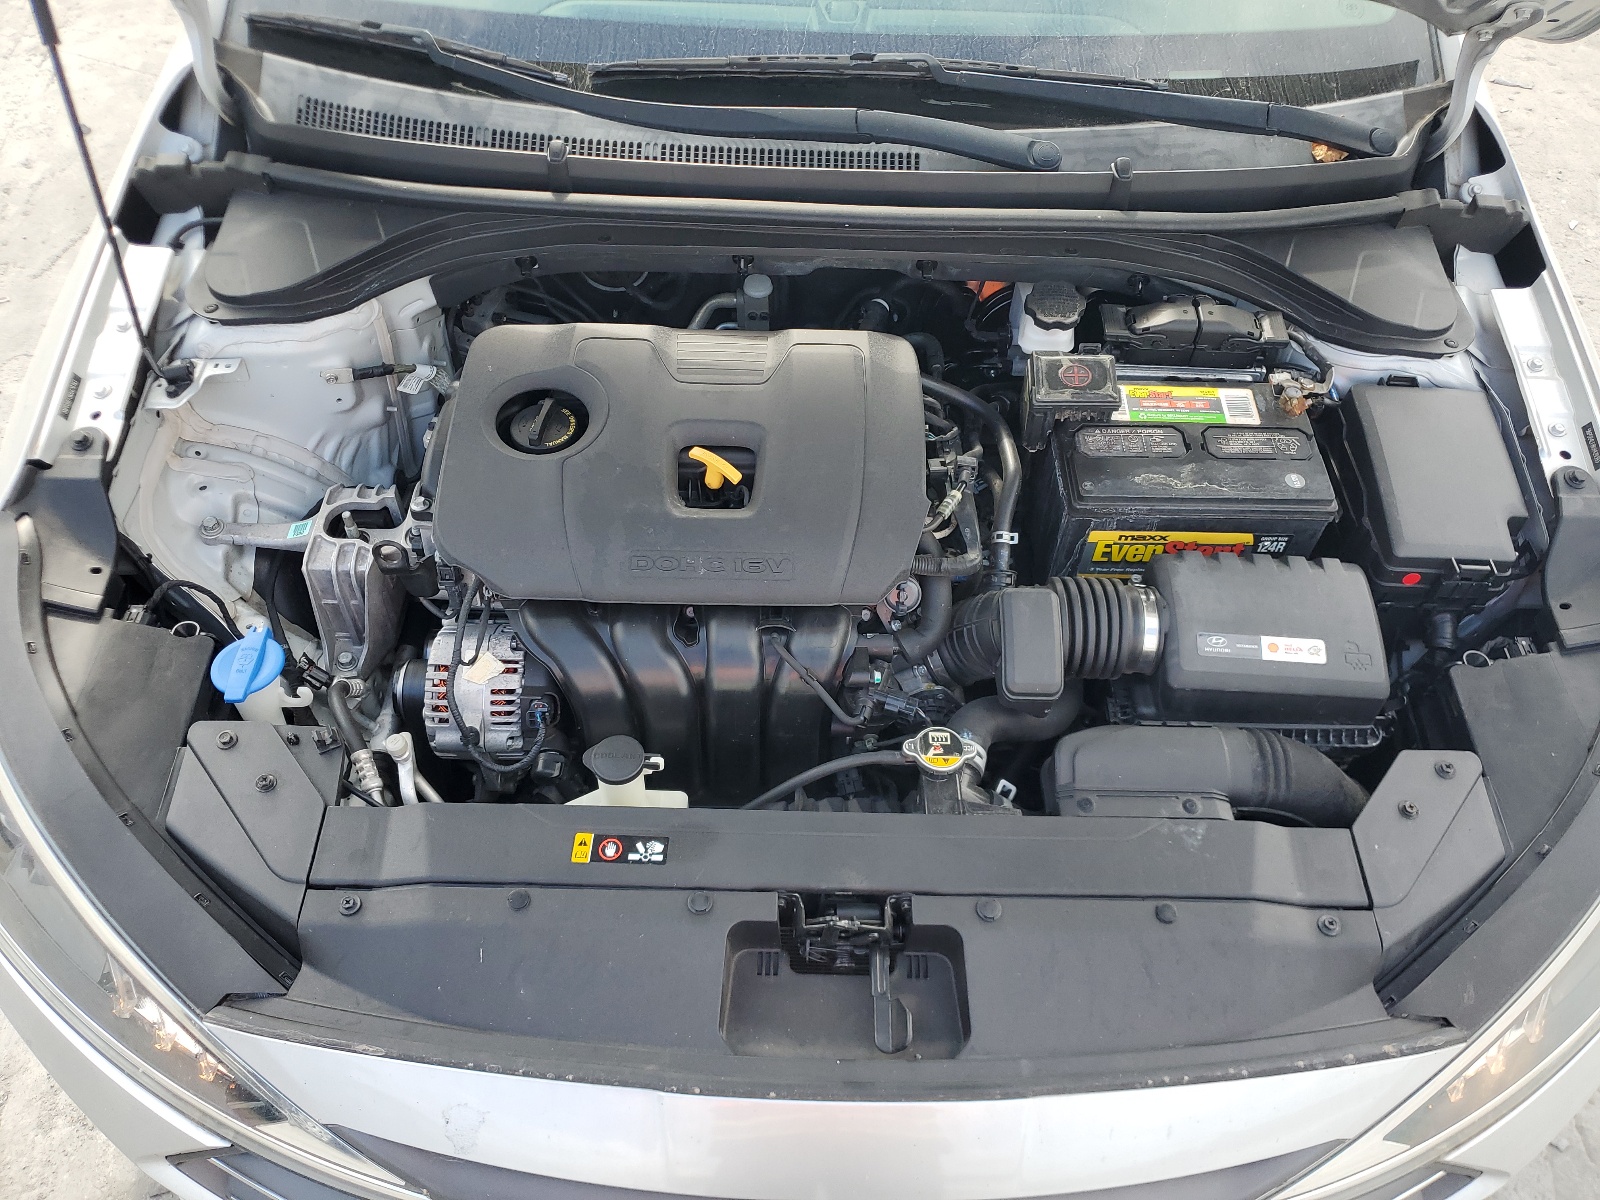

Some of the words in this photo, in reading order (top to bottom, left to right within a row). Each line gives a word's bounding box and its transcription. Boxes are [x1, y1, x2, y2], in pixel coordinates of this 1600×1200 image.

[1118, 534, 1169, 542] maxx
[1257, 541, 1286, 553] 124R
[630, 555, 726, 573] DOHC
[733, 557, 790, 573] 16V
[593, 751, 641, 759] COOLANT
